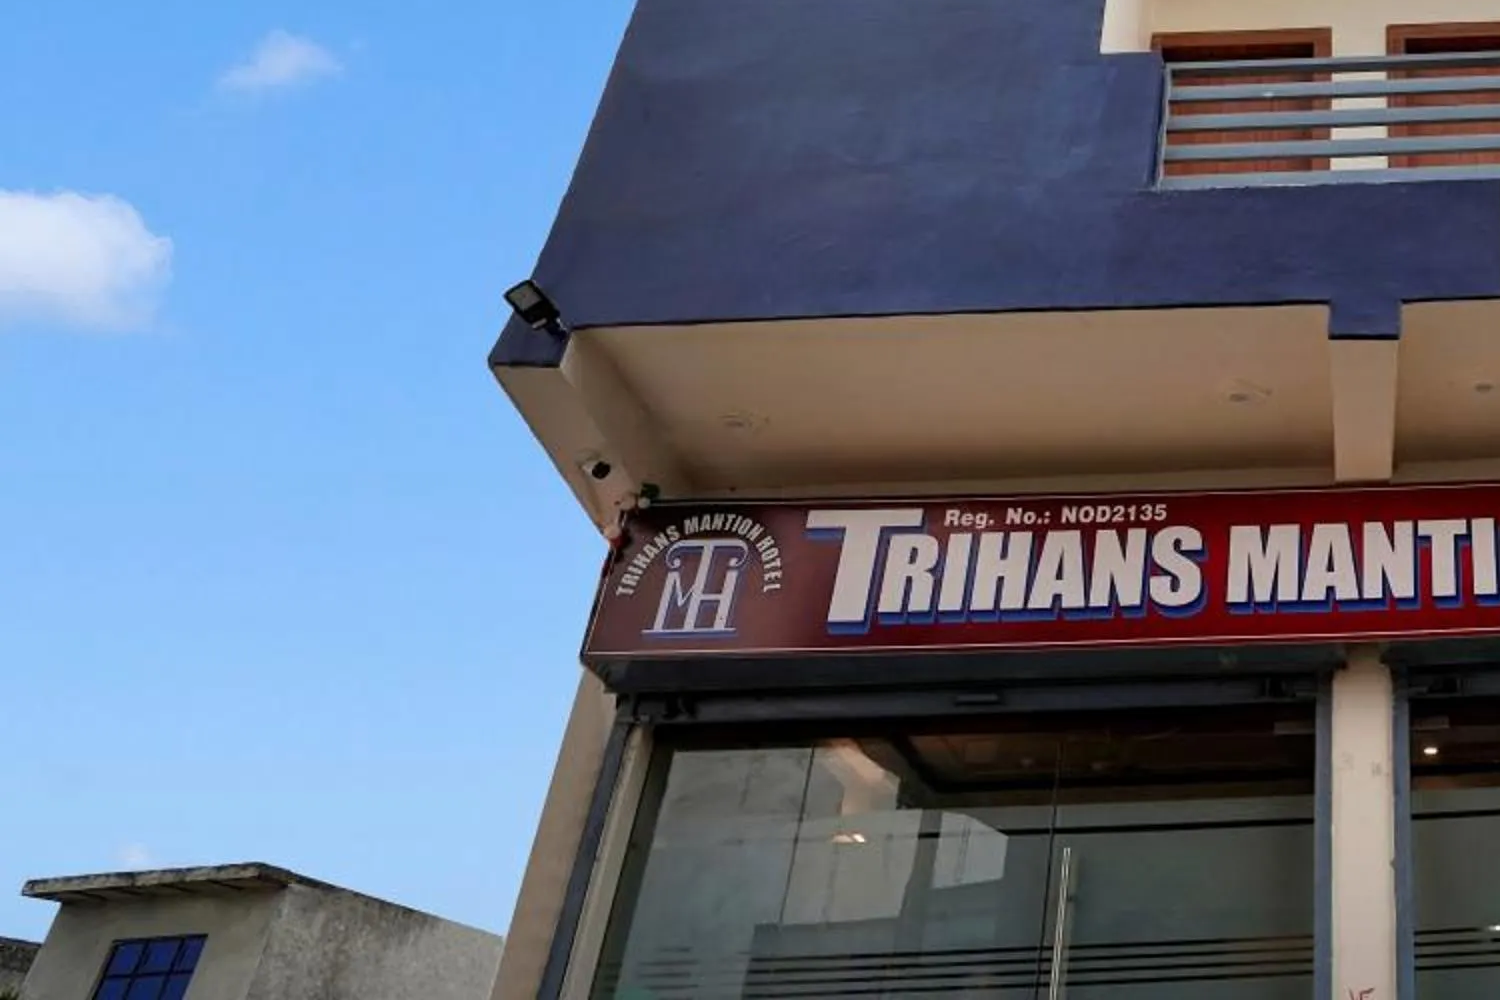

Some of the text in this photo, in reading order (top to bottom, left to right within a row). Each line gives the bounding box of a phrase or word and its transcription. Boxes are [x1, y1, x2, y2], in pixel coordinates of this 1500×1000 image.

[616, 514, 785, 597] TRIHANS MANTION HOTEL
[943, 503, 1167, 527] Reg. No.: NOD2135
[805, 507, 1205, 633] TRIHANS
